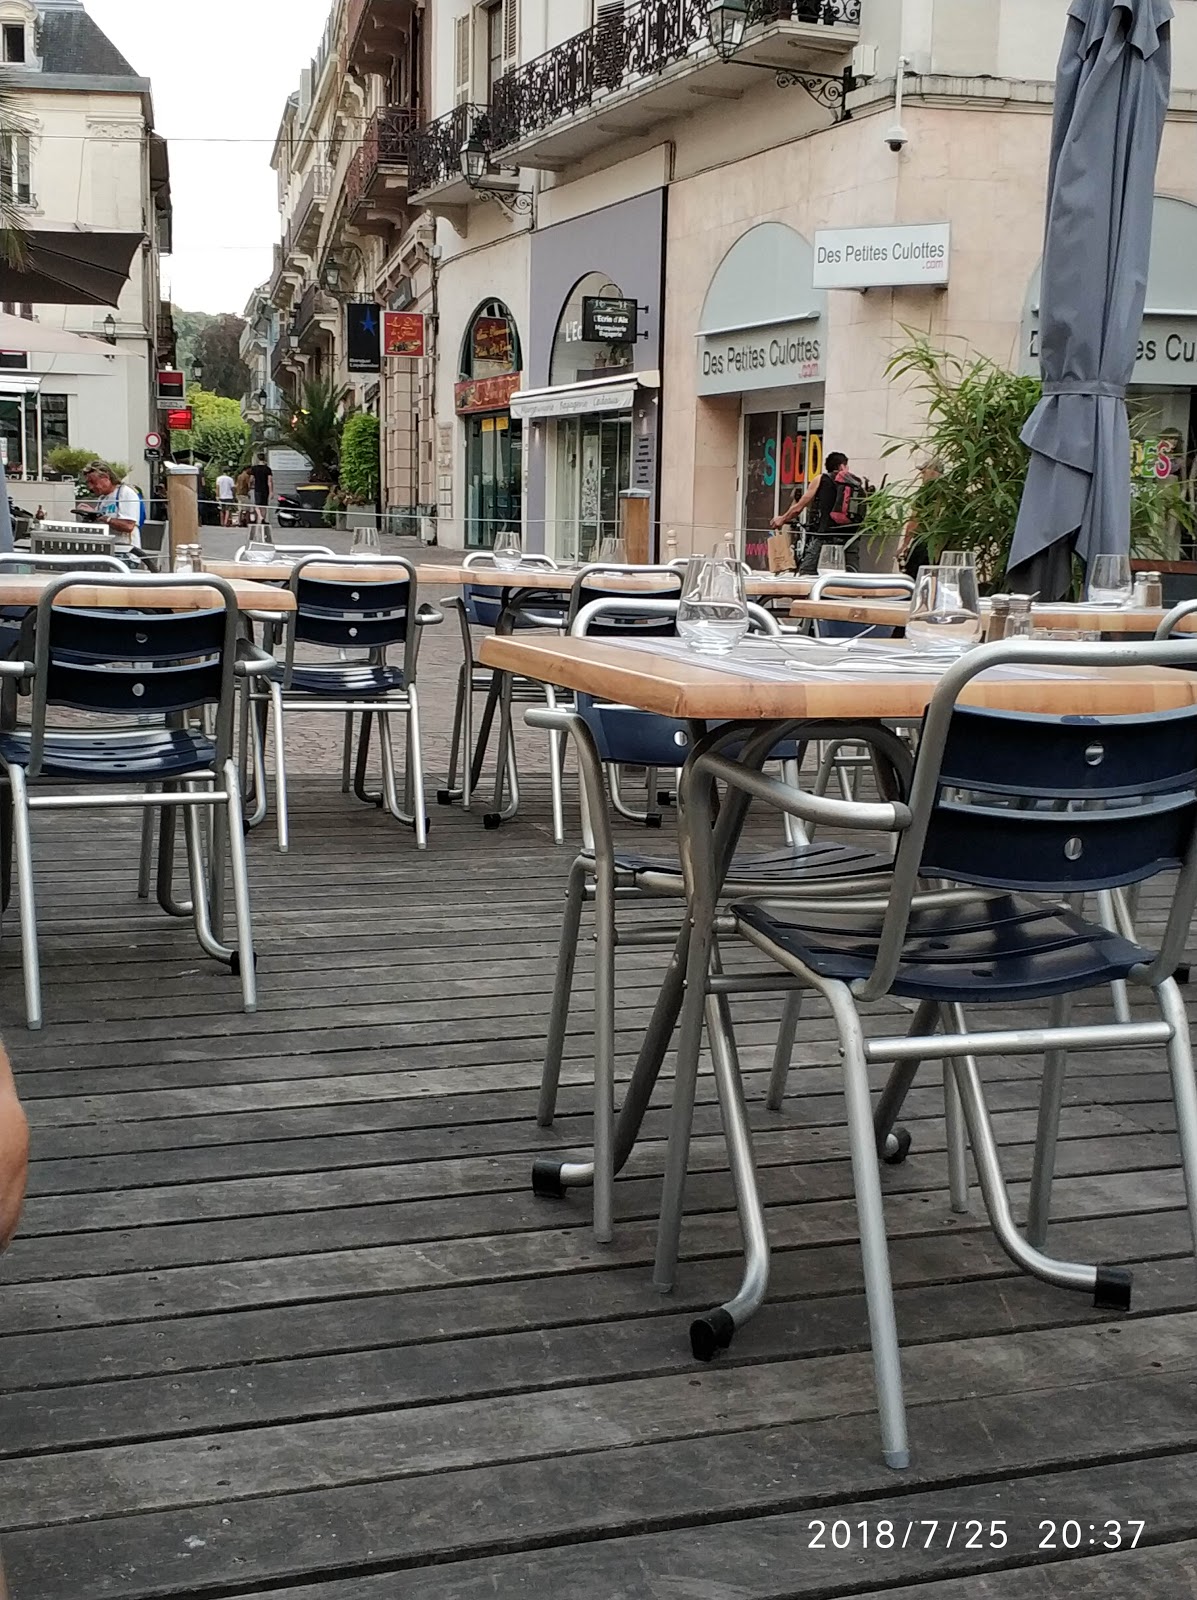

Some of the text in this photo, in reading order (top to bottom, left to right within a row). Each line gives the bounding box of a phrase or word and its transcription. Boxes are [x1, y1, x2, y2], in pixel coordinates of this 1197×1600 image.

[817, 241, 945, 264] Des Petites Culottes
[922, 259, 943, 270] .com
[703, 337, 821, 376] Des Petites Culottes
[1165, 333, 1197, 363] Cu
[798, 362, 820, 379] .com
